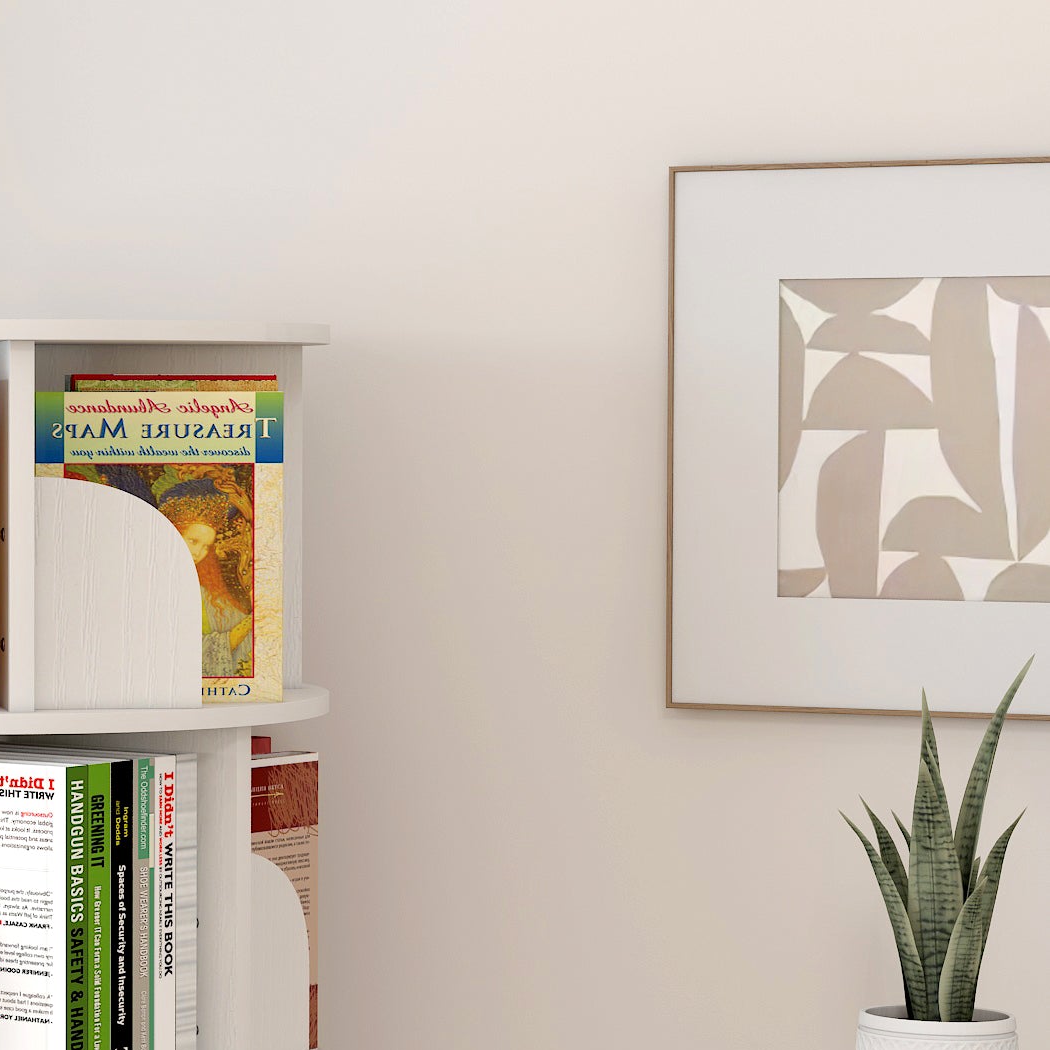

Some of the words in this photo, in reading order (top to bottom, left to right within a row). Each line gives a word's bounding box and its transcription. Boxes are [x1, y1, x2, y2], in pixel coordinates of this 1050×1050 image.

[140, 767, 148, 780] The
[164, 771, 174, 781] I
[71, 780, 83, 860] HANDGUN
[91, 794, 104, 854] GREENING
[140, 781, 148, 849] Oddshoefinder.com
[164, 784, 174, 838] Didn't
[91, 859, 104, 868] IT
[140, 866, 148, 888] SHOE
[165, 842, 173, 889] WRITE
[71, 864, 83, 922] BASICS
[94, 886, 102, 899] How
[117, 864, 126, 900] Spaces
[94, 900, 102, 925] Greener
[119, 901, 127, 911] of
[140, 890, 148, 930] WEARER'S
[165, 893, 173, 928] THIS
[94, 934, 102, 946] Can
[117, 913, 126, 954] Security
[71, 928, 83, 984] SAFETY
[94, 947, 102, 962] Form
[118, 956, 126, 974] and
[140, 933, 148, 978] HANDBOOK
[165, 932, 173, 976] BOOK
[94, 970, 102, 985] Solid
[71, 991, 80, 1003] &
[94, 987, 102, 1022] Foundation
[117, 976, 126, 1025] Insecurity
[94, 1023, 102, 1033] For
